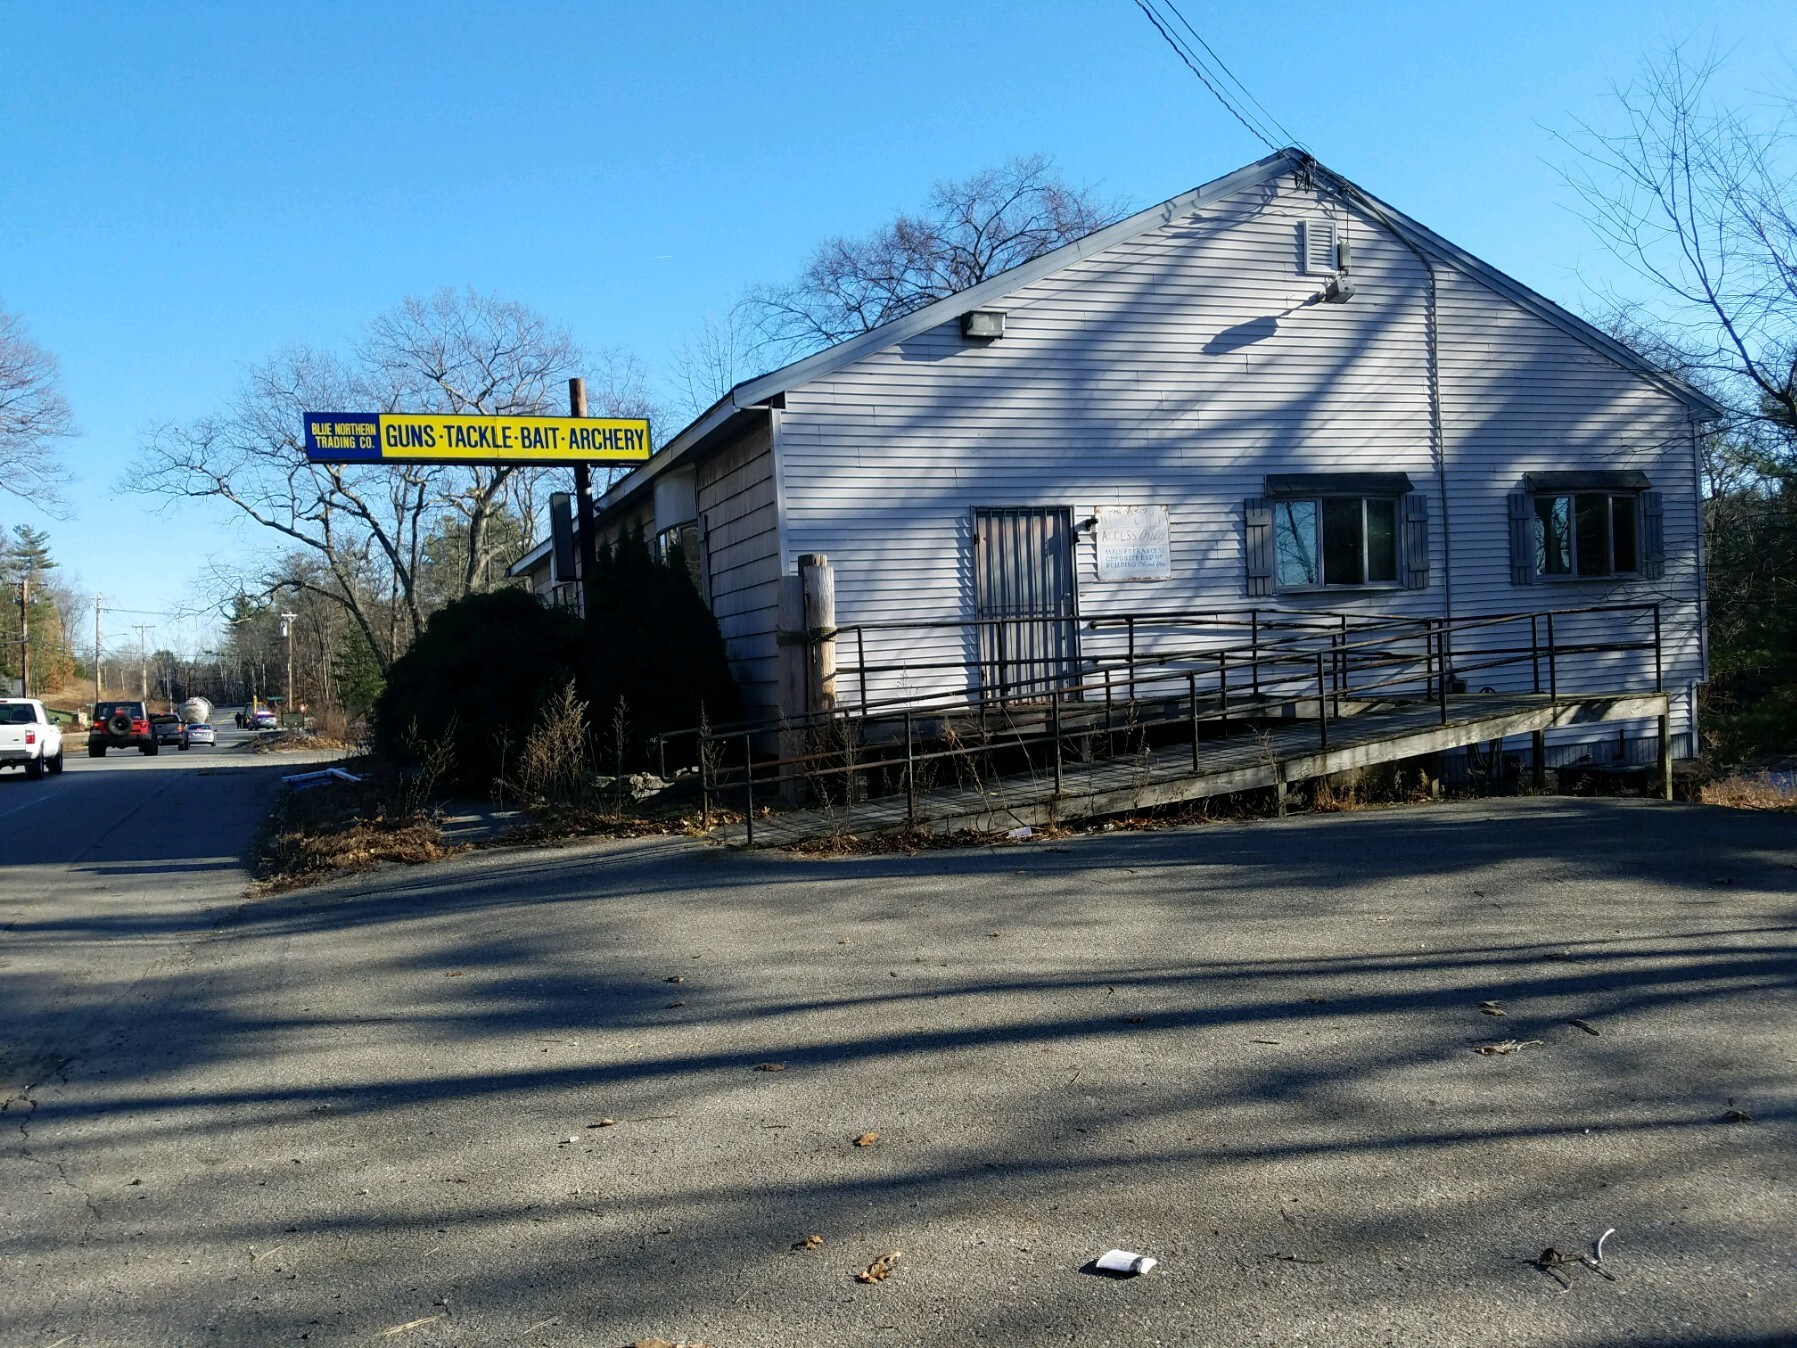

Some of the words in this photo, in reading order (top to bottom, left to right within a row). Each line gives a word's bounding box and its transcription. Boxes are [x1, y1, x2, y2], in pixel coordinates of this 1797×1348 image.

[311, 422, 333, 436] BLUE
[334, 423, 376, 437] NORTHERN
[315, 435, 357, 449] TRADING
[359, 436, 376, 449] CO.
[385, 424, 436, 448] GUNS
[443, 425, 513, 449] TACKLE
[522, 427, 559, 450] BAIT
[568, 428, 645, 451] ARCHERY
